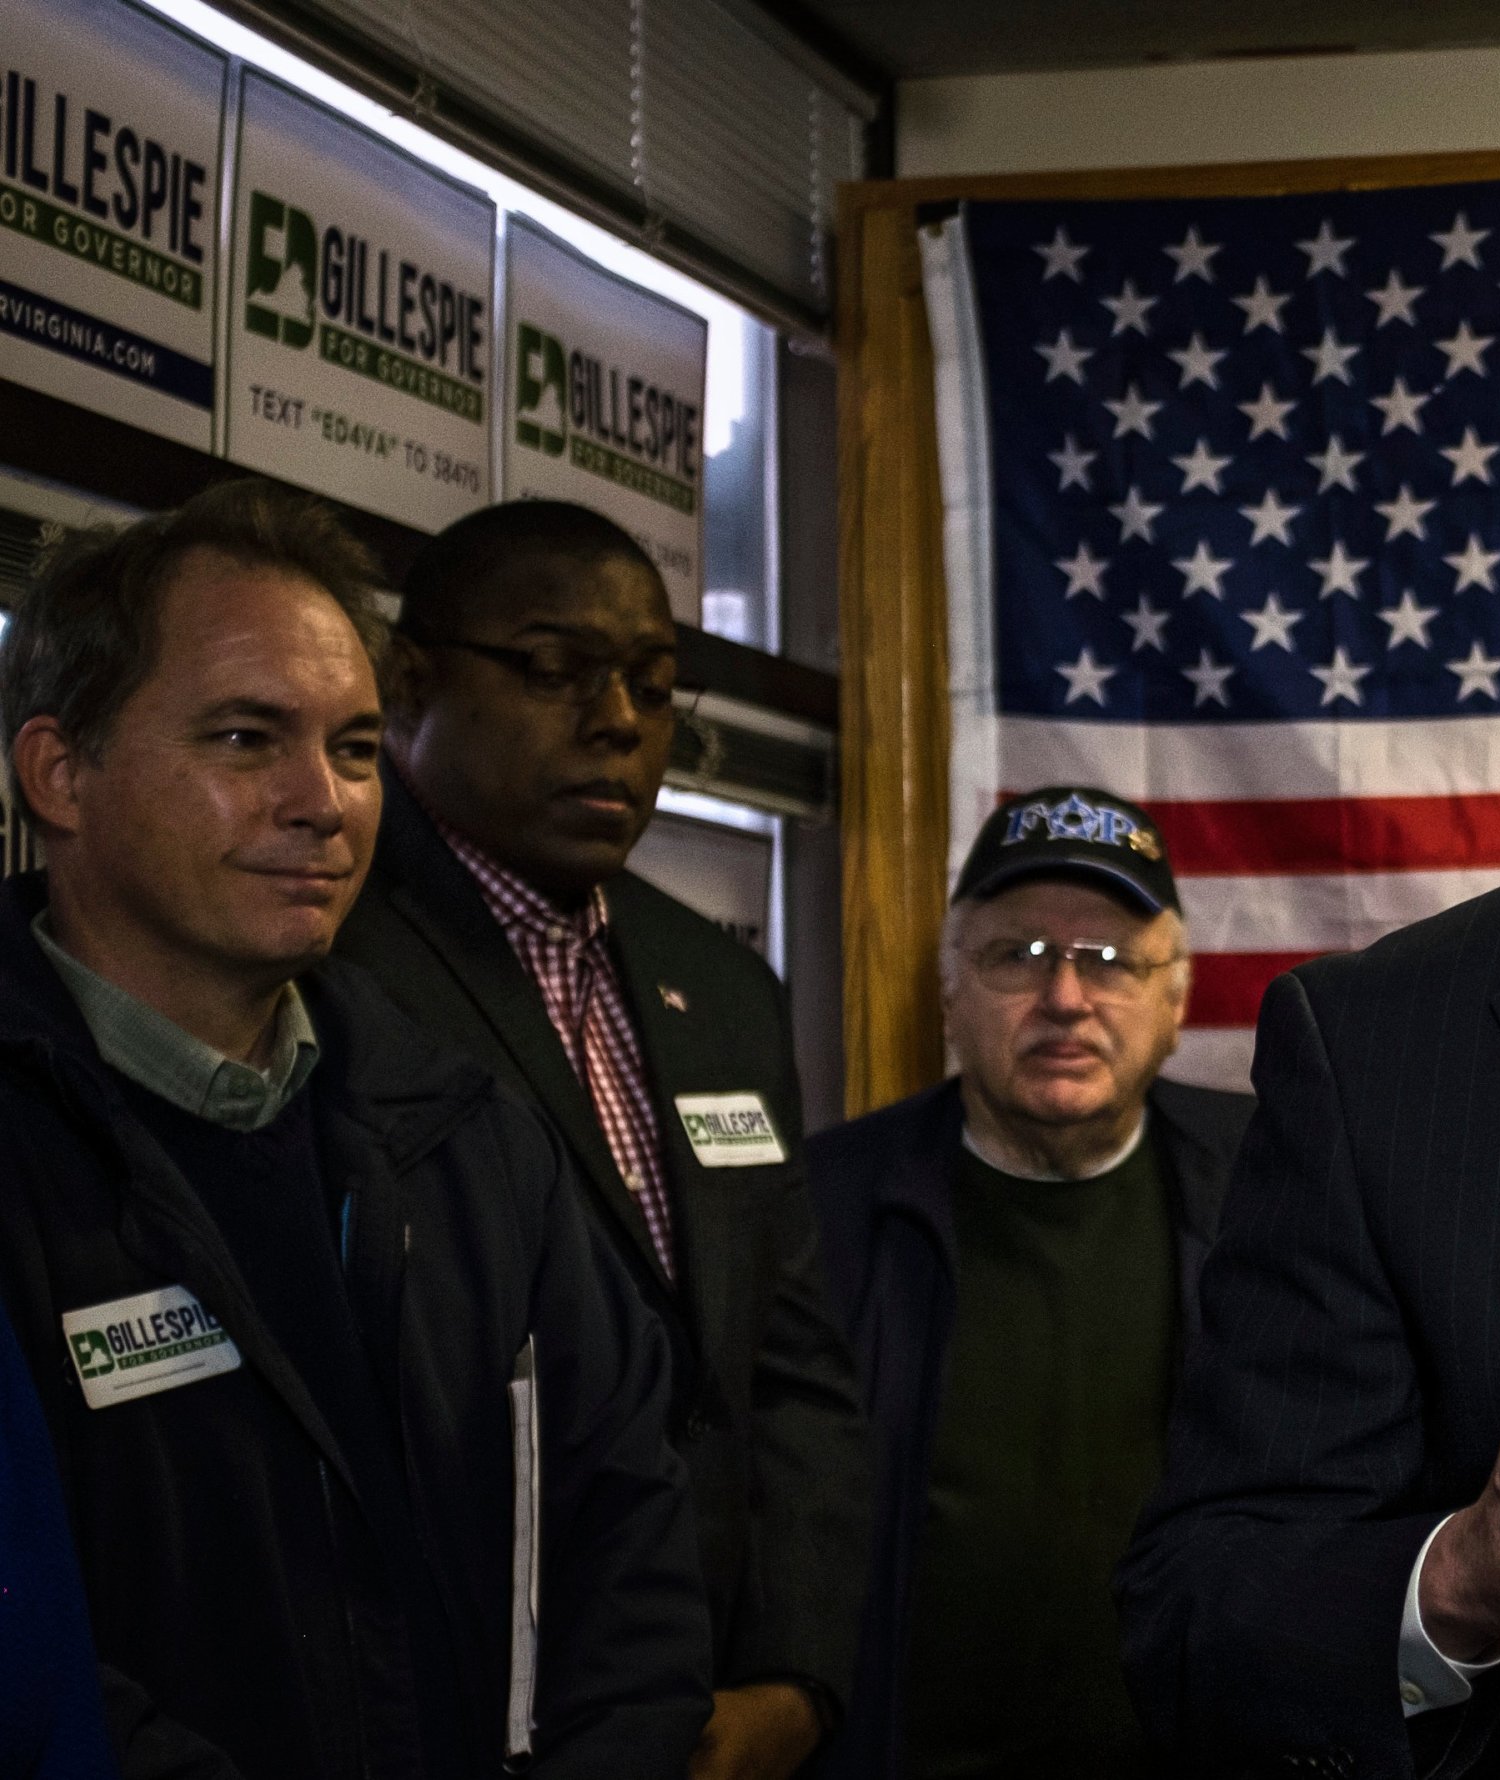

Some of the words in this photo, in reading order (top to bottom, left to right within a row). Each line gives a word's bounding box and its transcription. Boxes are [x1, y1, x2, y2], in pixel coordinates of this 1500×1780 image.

[0, 70, 206, 266] ILLESPIE
[54, 215, 193, 299] GOVERNOR
[322, 226, 483, 384] GILLESPIE
[326, 331, 368, 370] FOR
[251, 384, 303, 428] TEXT
[404, 439, 428, 474] TO
[570, 351, 696, 478] GILLESPIE
[705, 1112, 770, 1135] GILLESPIE
